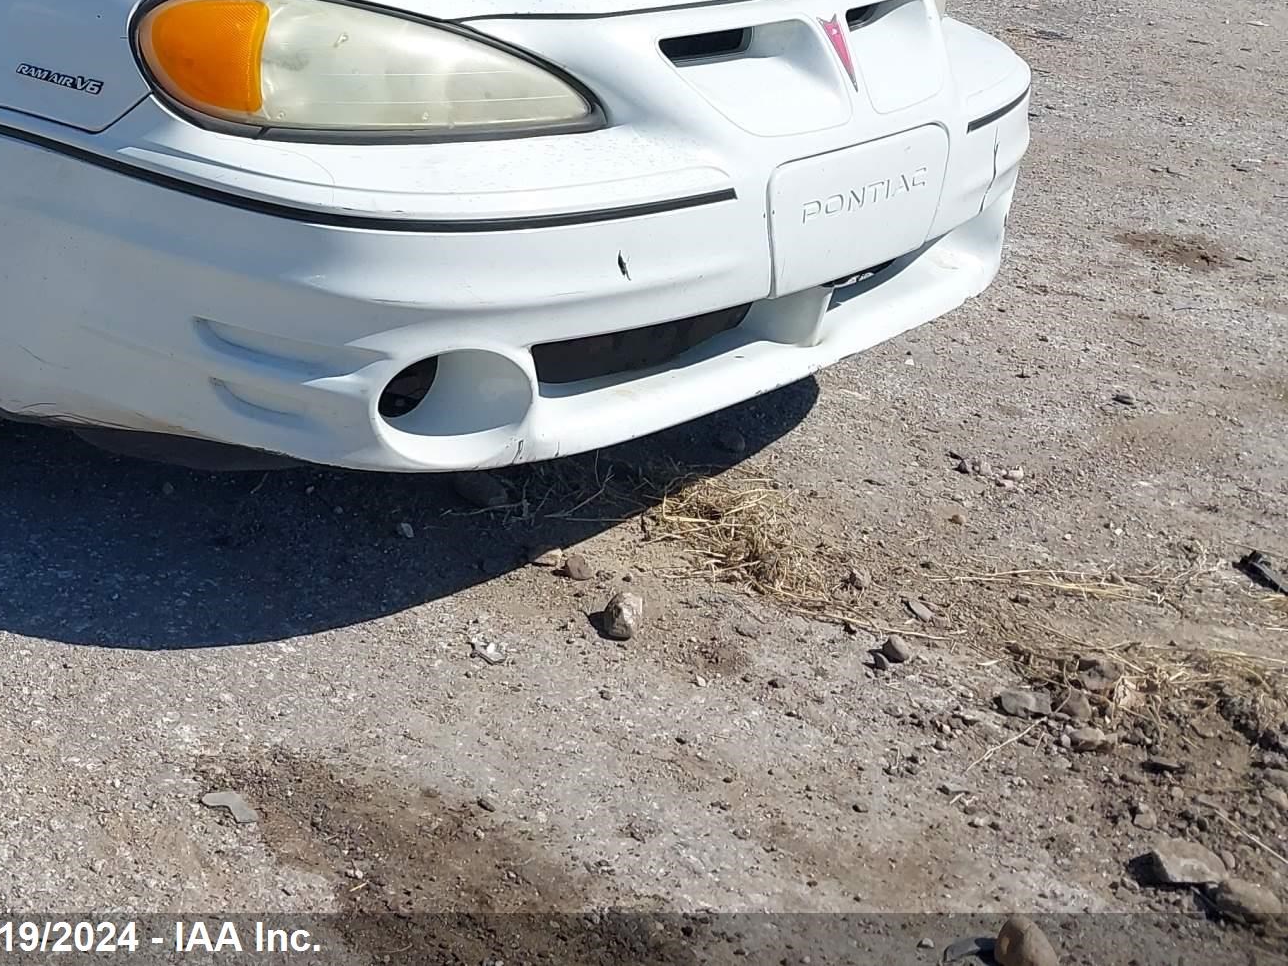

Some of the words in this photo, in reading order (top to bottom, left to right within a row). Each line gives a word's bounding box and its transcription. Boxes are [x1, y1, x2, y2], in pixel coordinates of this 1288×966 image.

[16, 63, 50, 81] RAM
[48, 73, 76, 88] AIR
[75, 76, 104, 95] V6
[802, 166, 927, 224] PONTIAC
